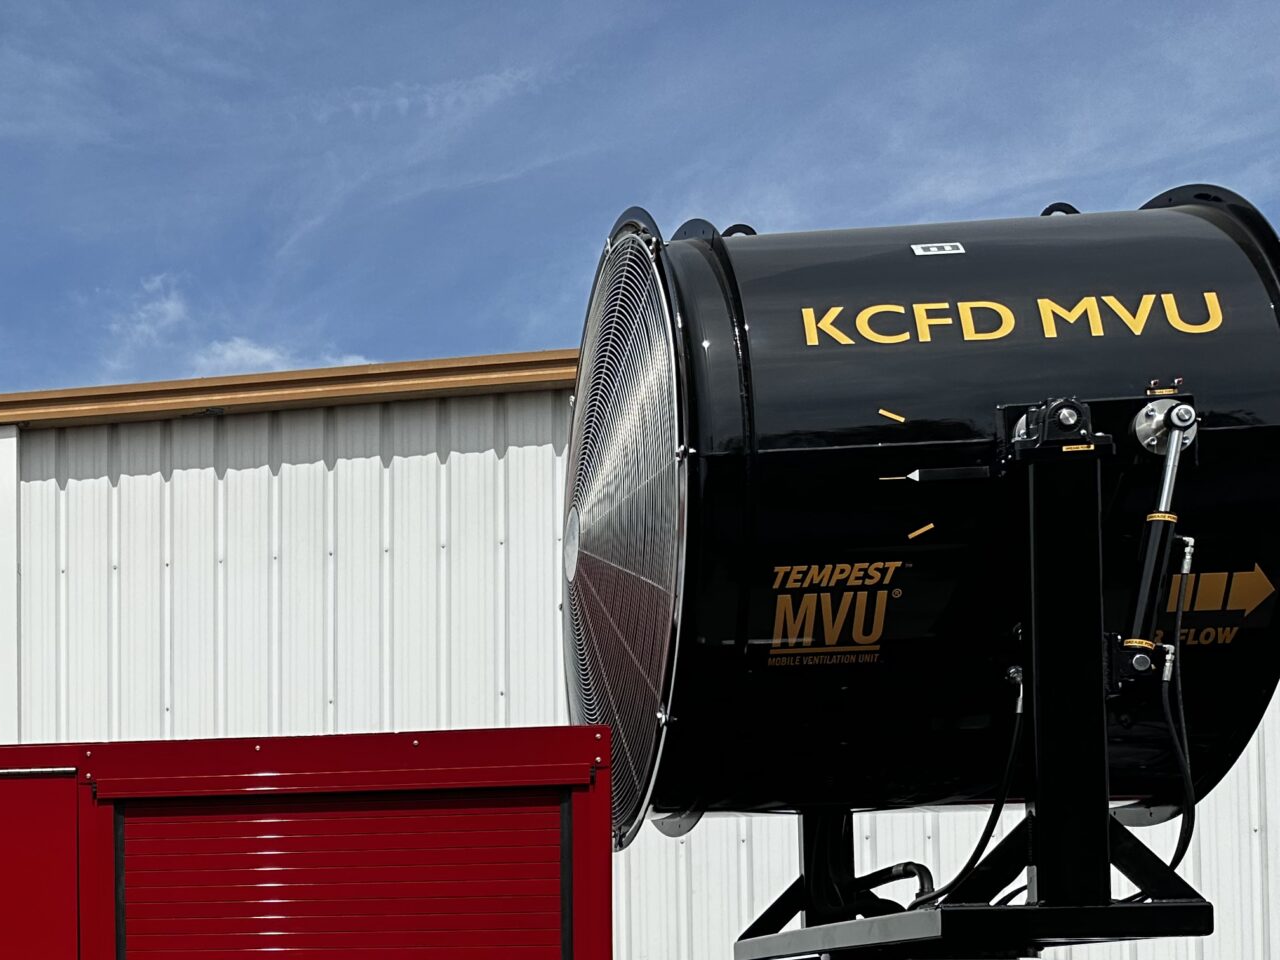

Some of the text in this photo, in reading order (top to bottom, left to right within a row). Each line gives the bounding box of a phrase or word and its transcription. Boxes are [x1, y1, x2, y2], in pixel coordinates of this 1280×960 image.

[801, 291, 1224, 346] KCFD MVU
[772, 560, 903, 589] TEMPEST
[768, 653, 880, 666] MOBILE VENTILATION UNIT
